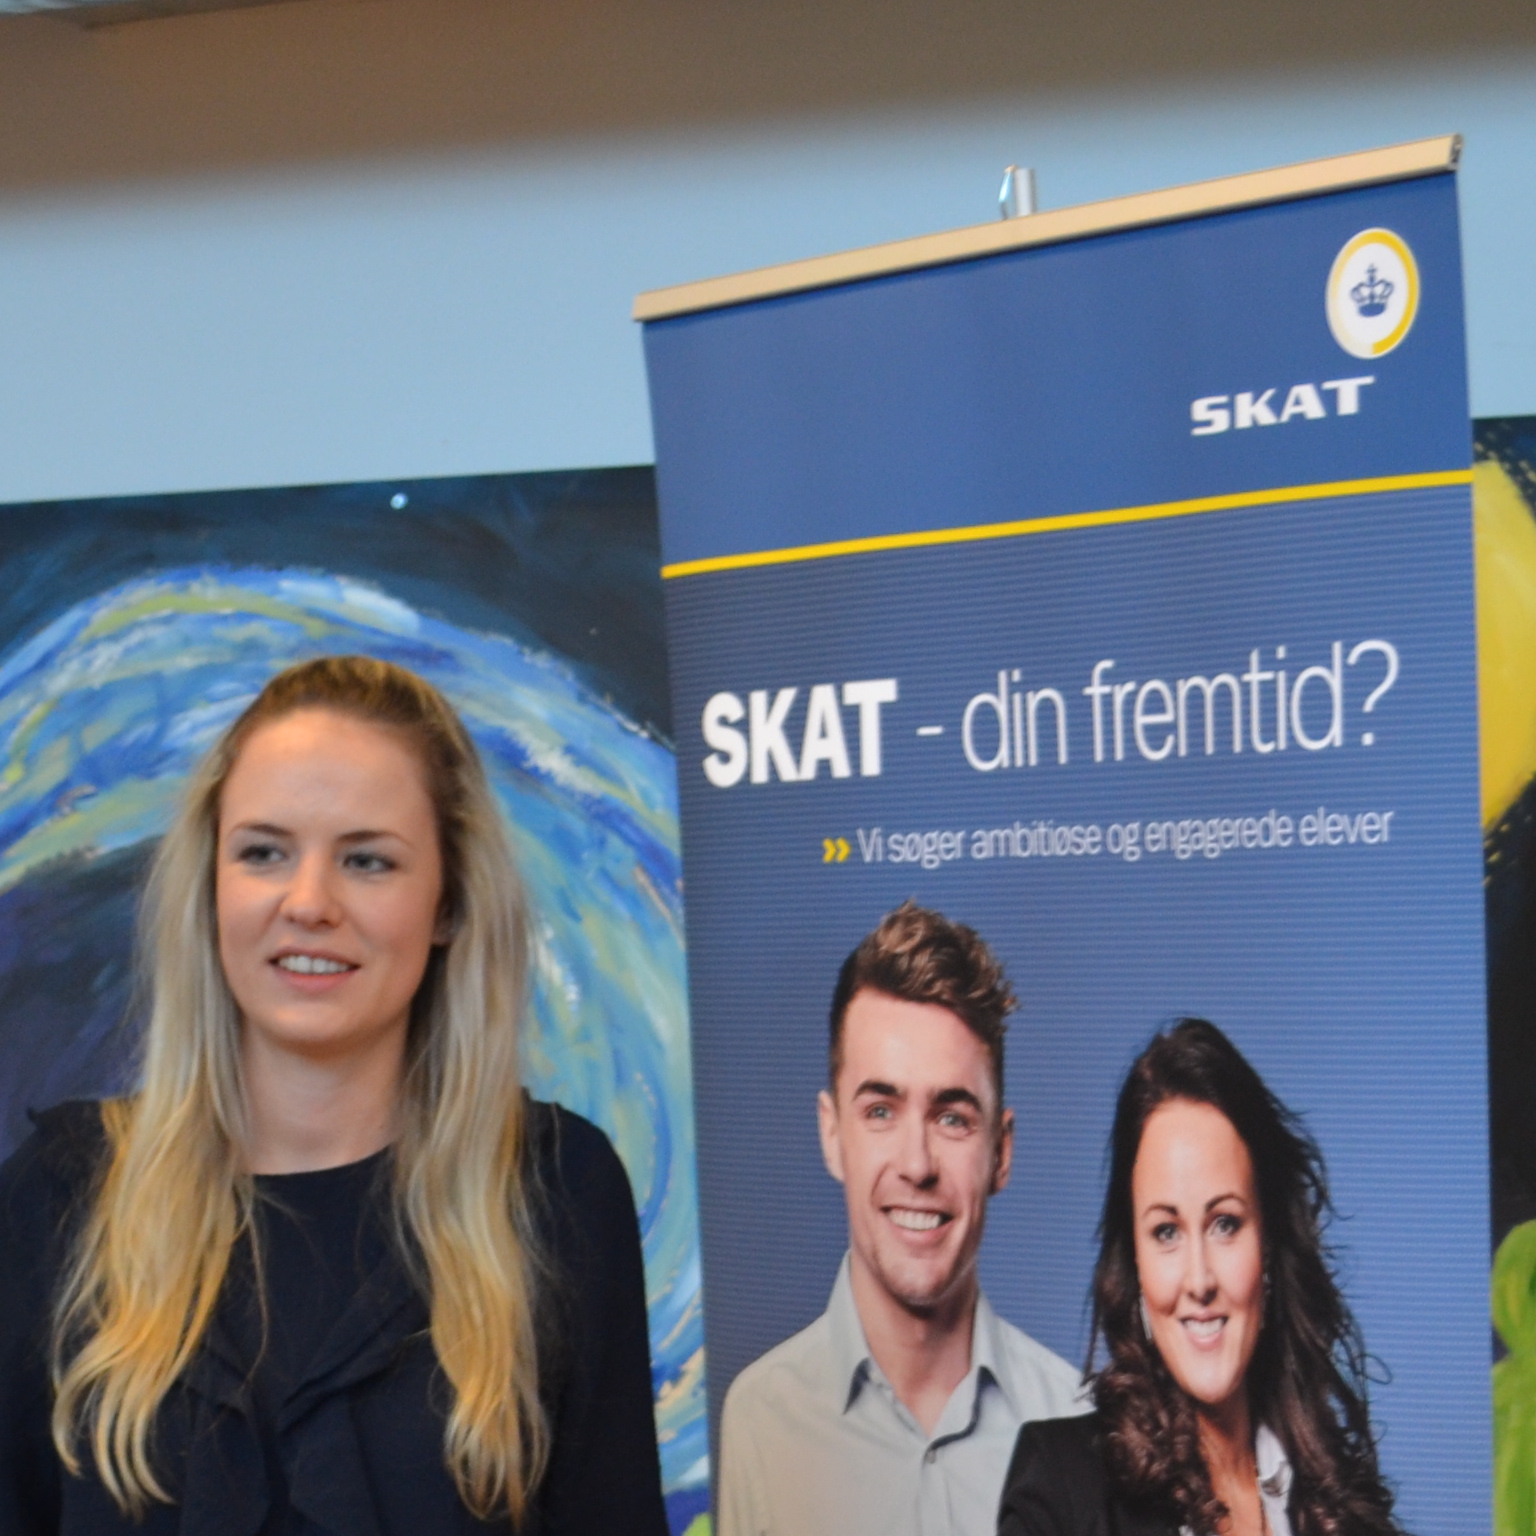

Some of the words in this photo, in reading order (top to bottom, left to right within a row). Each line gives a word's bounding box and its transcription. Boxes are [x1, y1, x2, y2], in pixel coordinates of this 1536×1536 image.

[1191, 376, 1376, 436] SKAT
[701, 678, 898, 788] SKAT
[962, 669, 1068, 772] din
[1083, 640, 1401, 763] fremtid?
[856, 826, 882, 863] Vi
[887, 829, 966, 869] søger
[970, 818, 1103, 859] ambitiøse
[1106, 821, 1141, 862] og
[1144, 808, 1293, 860] engagerede
[1298, 806, 1394, 847] elever
